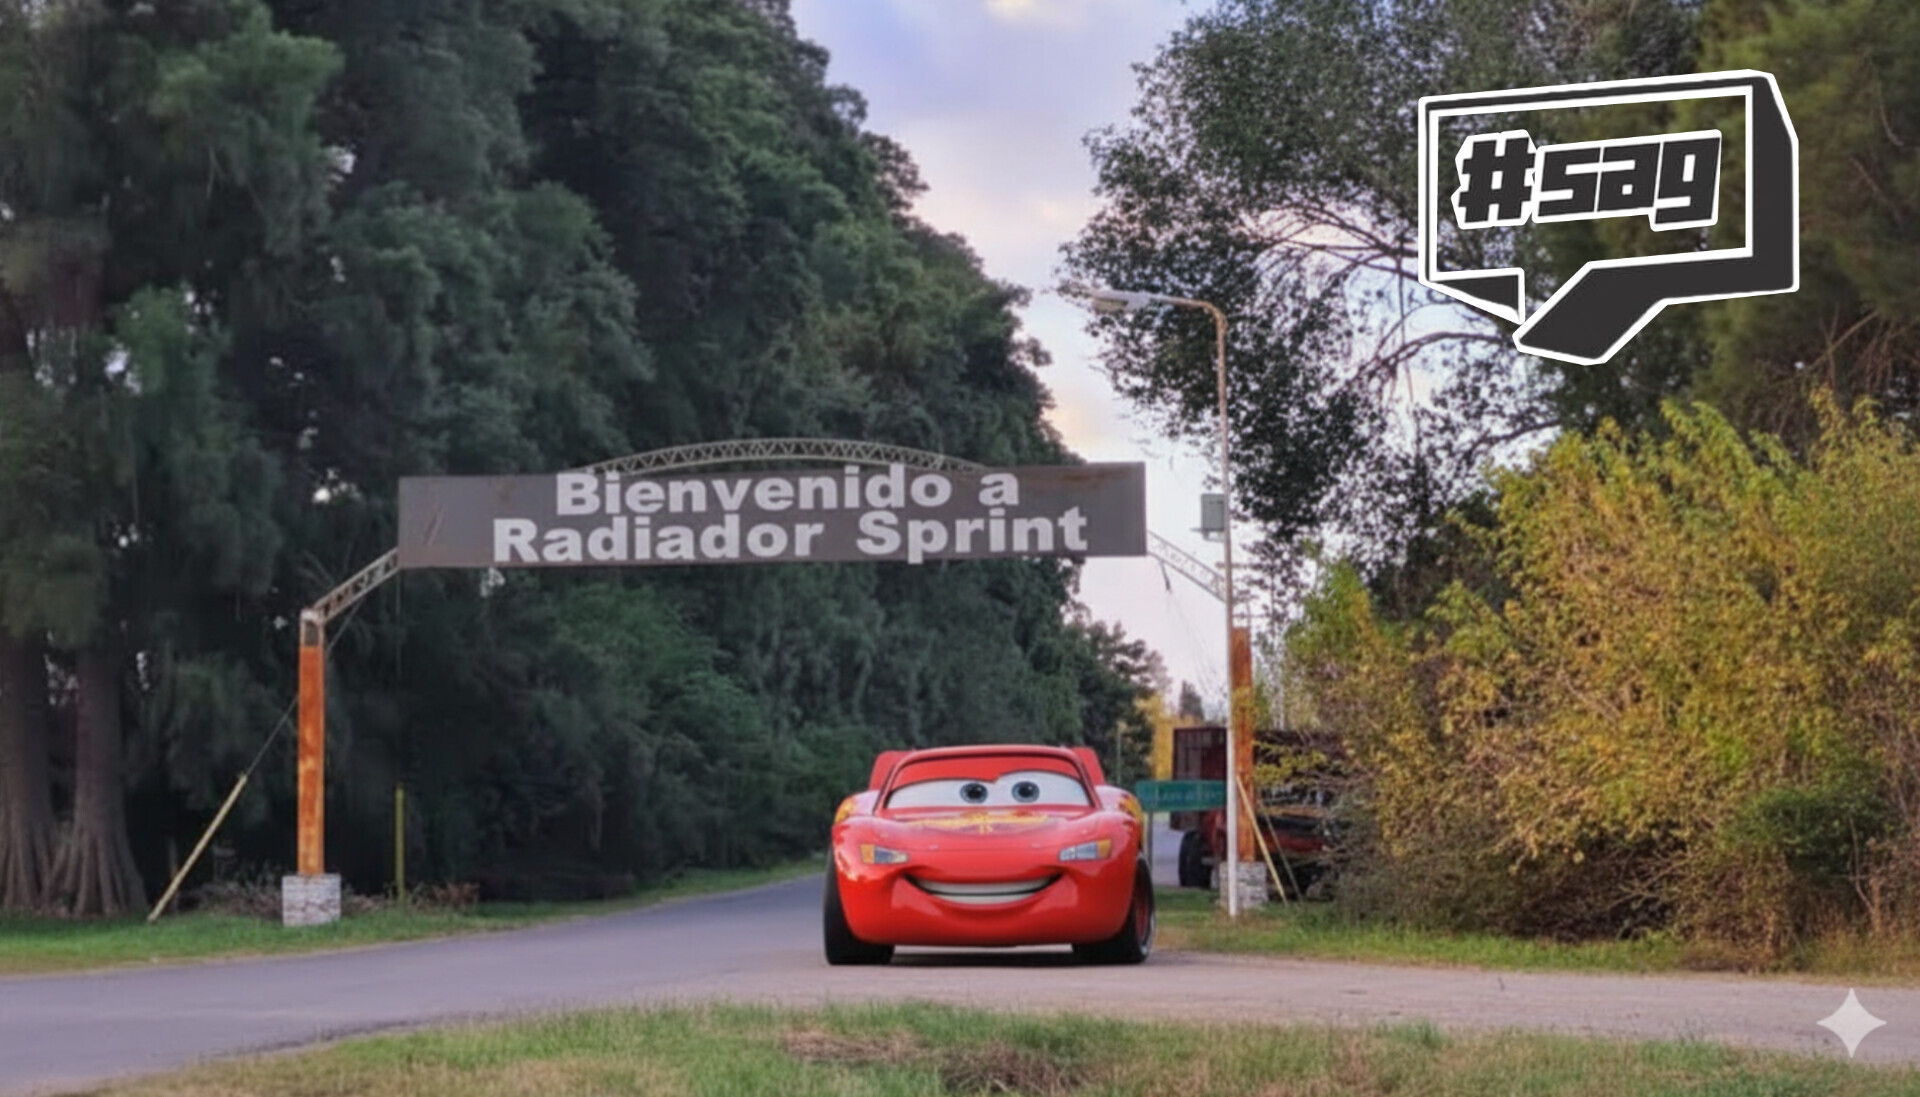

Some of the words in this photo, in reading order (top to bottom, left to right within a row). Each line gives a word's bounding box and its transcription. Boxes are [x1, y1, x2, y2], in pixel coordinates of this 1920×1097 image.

[556, 463, 952, 515] Bienvenido
[978, 472, 1020, 506] a
[493, 513, 825, 563] Radiador
[856, 506, 1088, 565] Sprint
